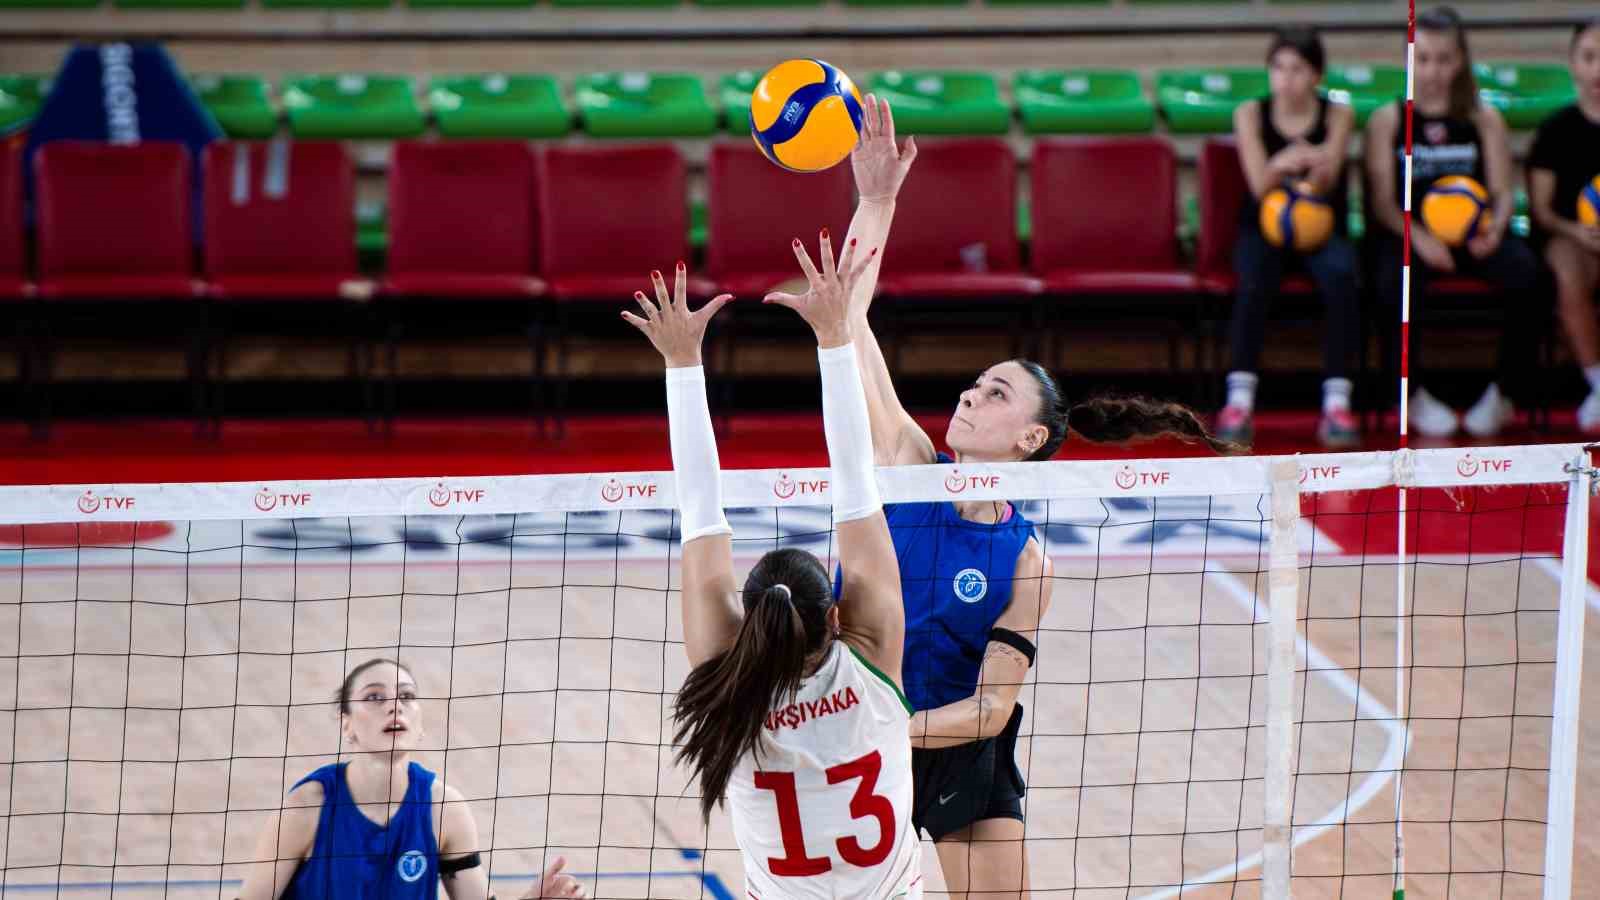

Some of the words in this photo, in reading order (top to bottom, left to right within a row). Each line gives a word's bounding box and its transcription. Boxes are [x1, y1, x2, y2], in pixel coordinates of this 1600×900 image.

[1481, 459, 1513, 472] TVF
[1140, 472, 1170, 485] TVF
[1311, 466, 1342, 479] TVF
[799, 480, 830, 494] TVF
[969, 476, 1001, 488] TVF
[454, 490, 485, 502] TVF
[626, 485, 657, 497] TVF
[103, 497, 135, 509] TVF
[280, 494, 311, 506] TVF
[764, 686, 860, 730] ARŞIYAKA
[754, 749, 897, 878] 13
